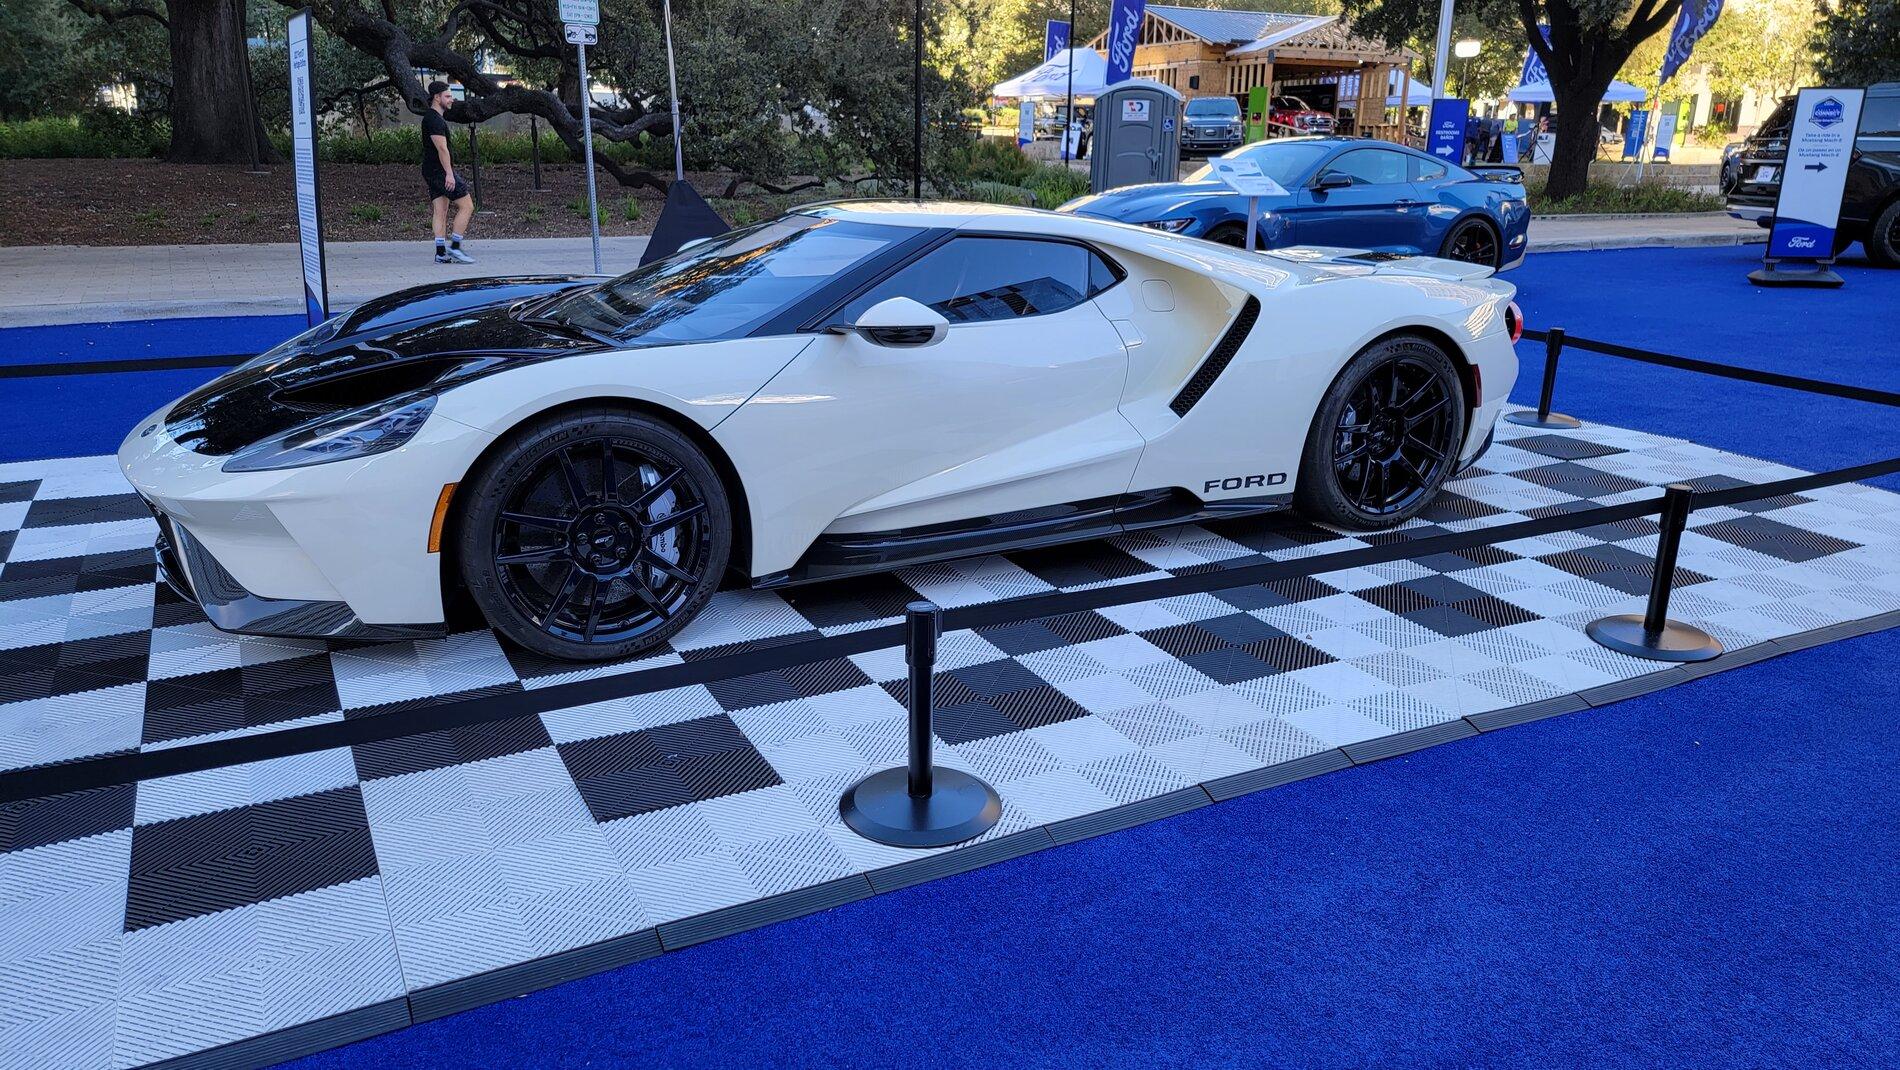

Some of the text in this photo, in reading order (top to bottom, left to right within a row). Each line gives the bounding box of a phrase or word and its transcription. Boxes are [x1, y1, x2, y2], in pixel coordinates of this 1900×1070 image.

[1112, 6, 1139, 74] Ford
[1788, 236, 1816, 248] Ford
[1203, 472, 1287, 493] FORD
